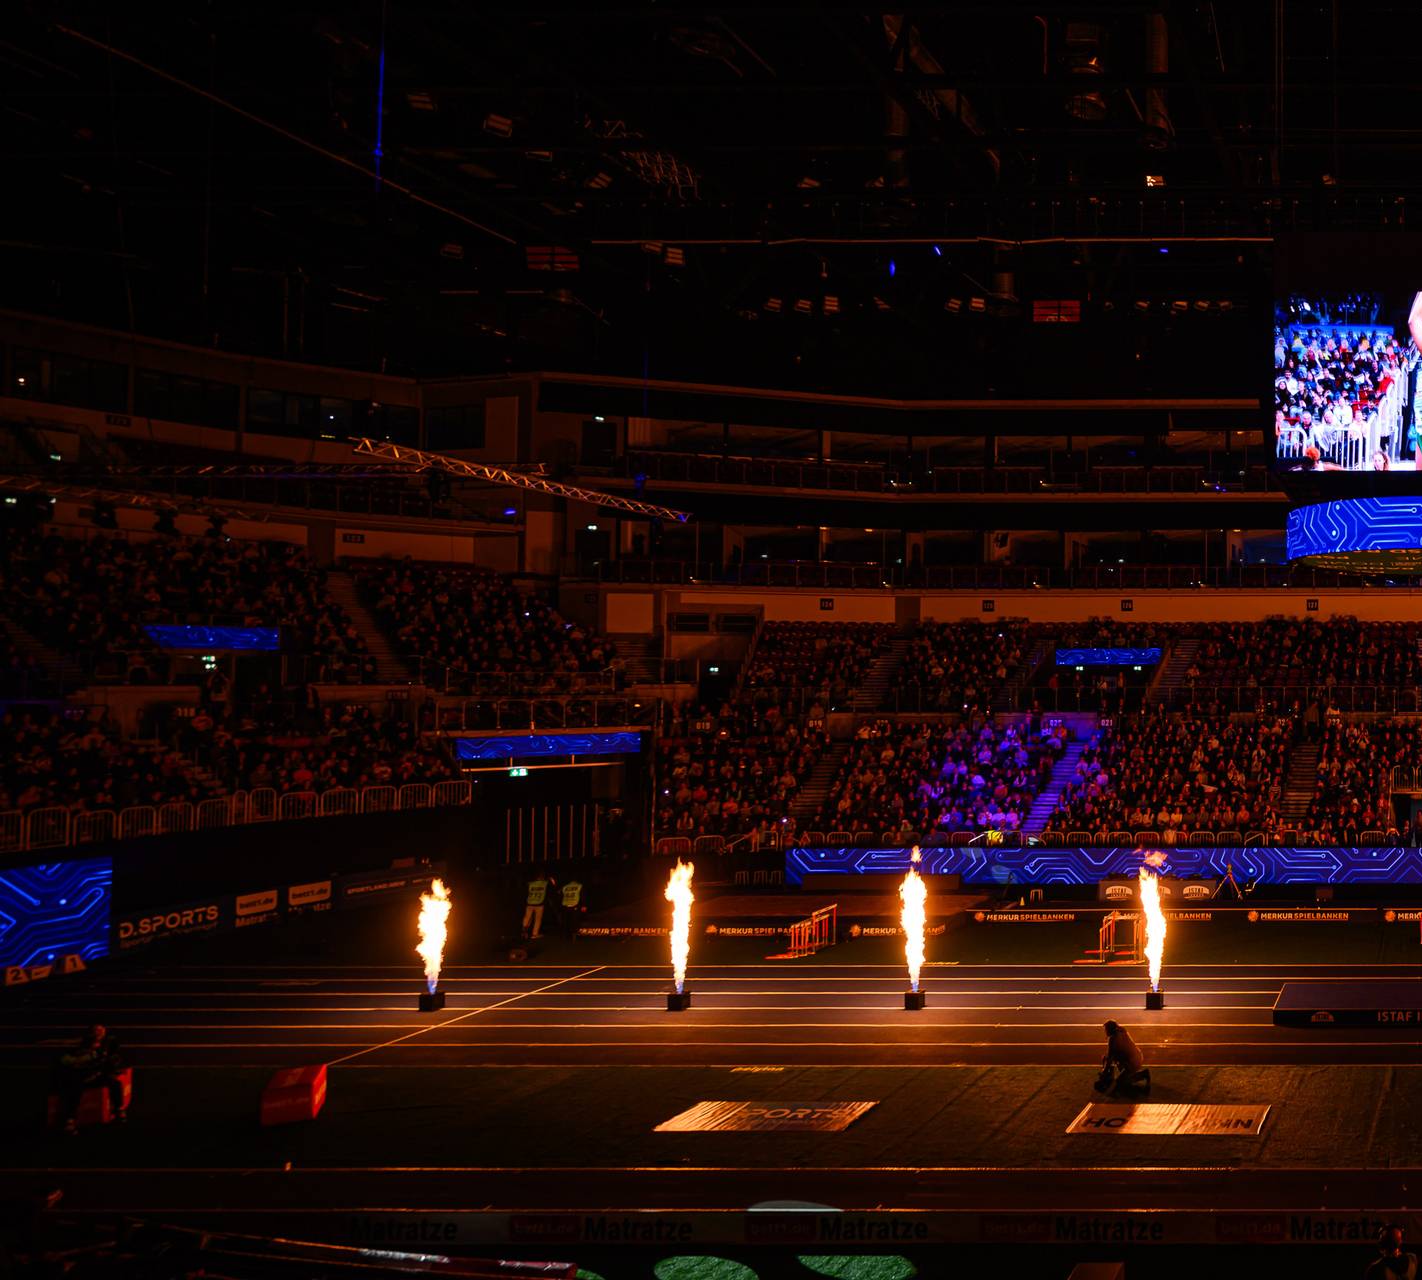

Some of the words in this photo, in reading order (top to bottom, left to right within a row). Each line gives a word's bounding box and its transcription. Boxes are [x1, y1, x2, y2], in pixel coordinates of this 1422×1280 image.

[118, 904, 220, 939] D.SPORTS
[863, 927, 897, 935] MERKUR
[10, 968, 21, 982] 2
[1376, 1011, 1412, 1022] ISTAF
[352, 1216, 458, 1241] Matratze
[584, 1216, 693, 1240] Matratze
[820, 1217, 929, 1240] Matratze
[1055, 1216, 1163, 1240] Matratze
[1289, 1216, 1382, 1240] Matrat
